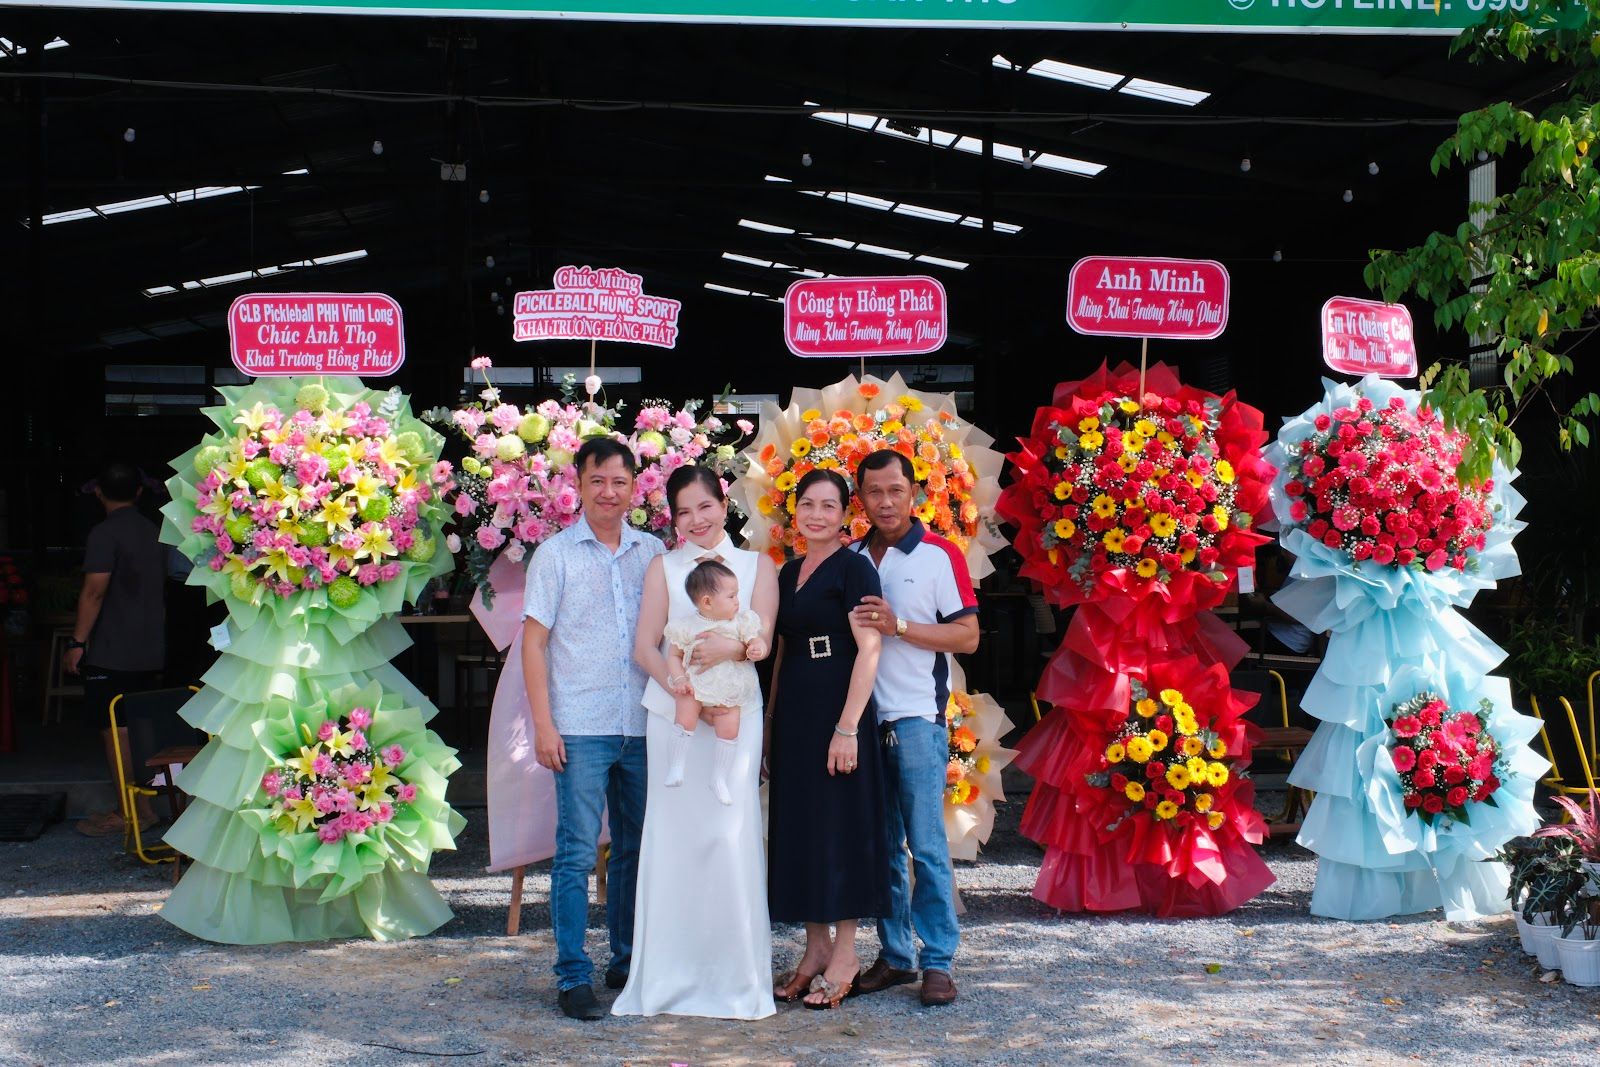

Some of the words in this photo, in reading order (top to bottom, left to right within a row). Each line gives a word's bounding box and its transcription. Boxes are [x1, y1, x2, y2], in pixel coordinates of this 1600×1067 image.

[558, 269, 596, 288] Chúc
[599, 268, 639, 296] Mừng
[1096, 266, 1142, 290] Anh
[1148, 269, 1206, 294] Minh
[239, 303, 261, 322] CLB
[264, 304, 314, 322] Pickleball
[342, 304, 365, 322] Vĩnh
[368, 304, 394, 326] Long
[518, 294, 594, 312] PICKLEBALL
[600, 292, 634, 314] HÙNG
[637, 300, 677, 320] SPORT
[798, 291, 834, 318] Công
[838, 292, 852, 318] ty
[856, 286, 896, 317] Hồng
[899, 288, 934, 312] Phát
[1075, 296, 1102, 323] Mừng
[1104, 296, 1130, 320] Khai
[1168, 299, 1194, 326] Hồng
[1196, 300, 1222, 327] Phát
[258, 324, 300, 344] Chúc
[305, 324, 339, 344] Anh
[345, 324, 376, 348] Thọ
[518, 320, 550, 337] KHAI
[552, 316, 600, 336] TRƯƠNG
[604, 314, 640, 338] HỒNG
[642, 318, 674, 344] PHÁT
[793, 322, 820, 346] Mừng
[823, 321, 848, 342] Khai
[886, 319, 912, 344] Hồng
[915, 320, 940, 343] Phát
[1328, 309, 1344, 334] Em
[1359, 312, 1390, 342] Quảng
[1392, 317, 1410, 341] Cáo
[245, 349, 274, 366] Khai
[279, 349, 324, 370] Trương
[327, 346, 360, 370] Hồng
[363, 349, 392, 366] Phát
